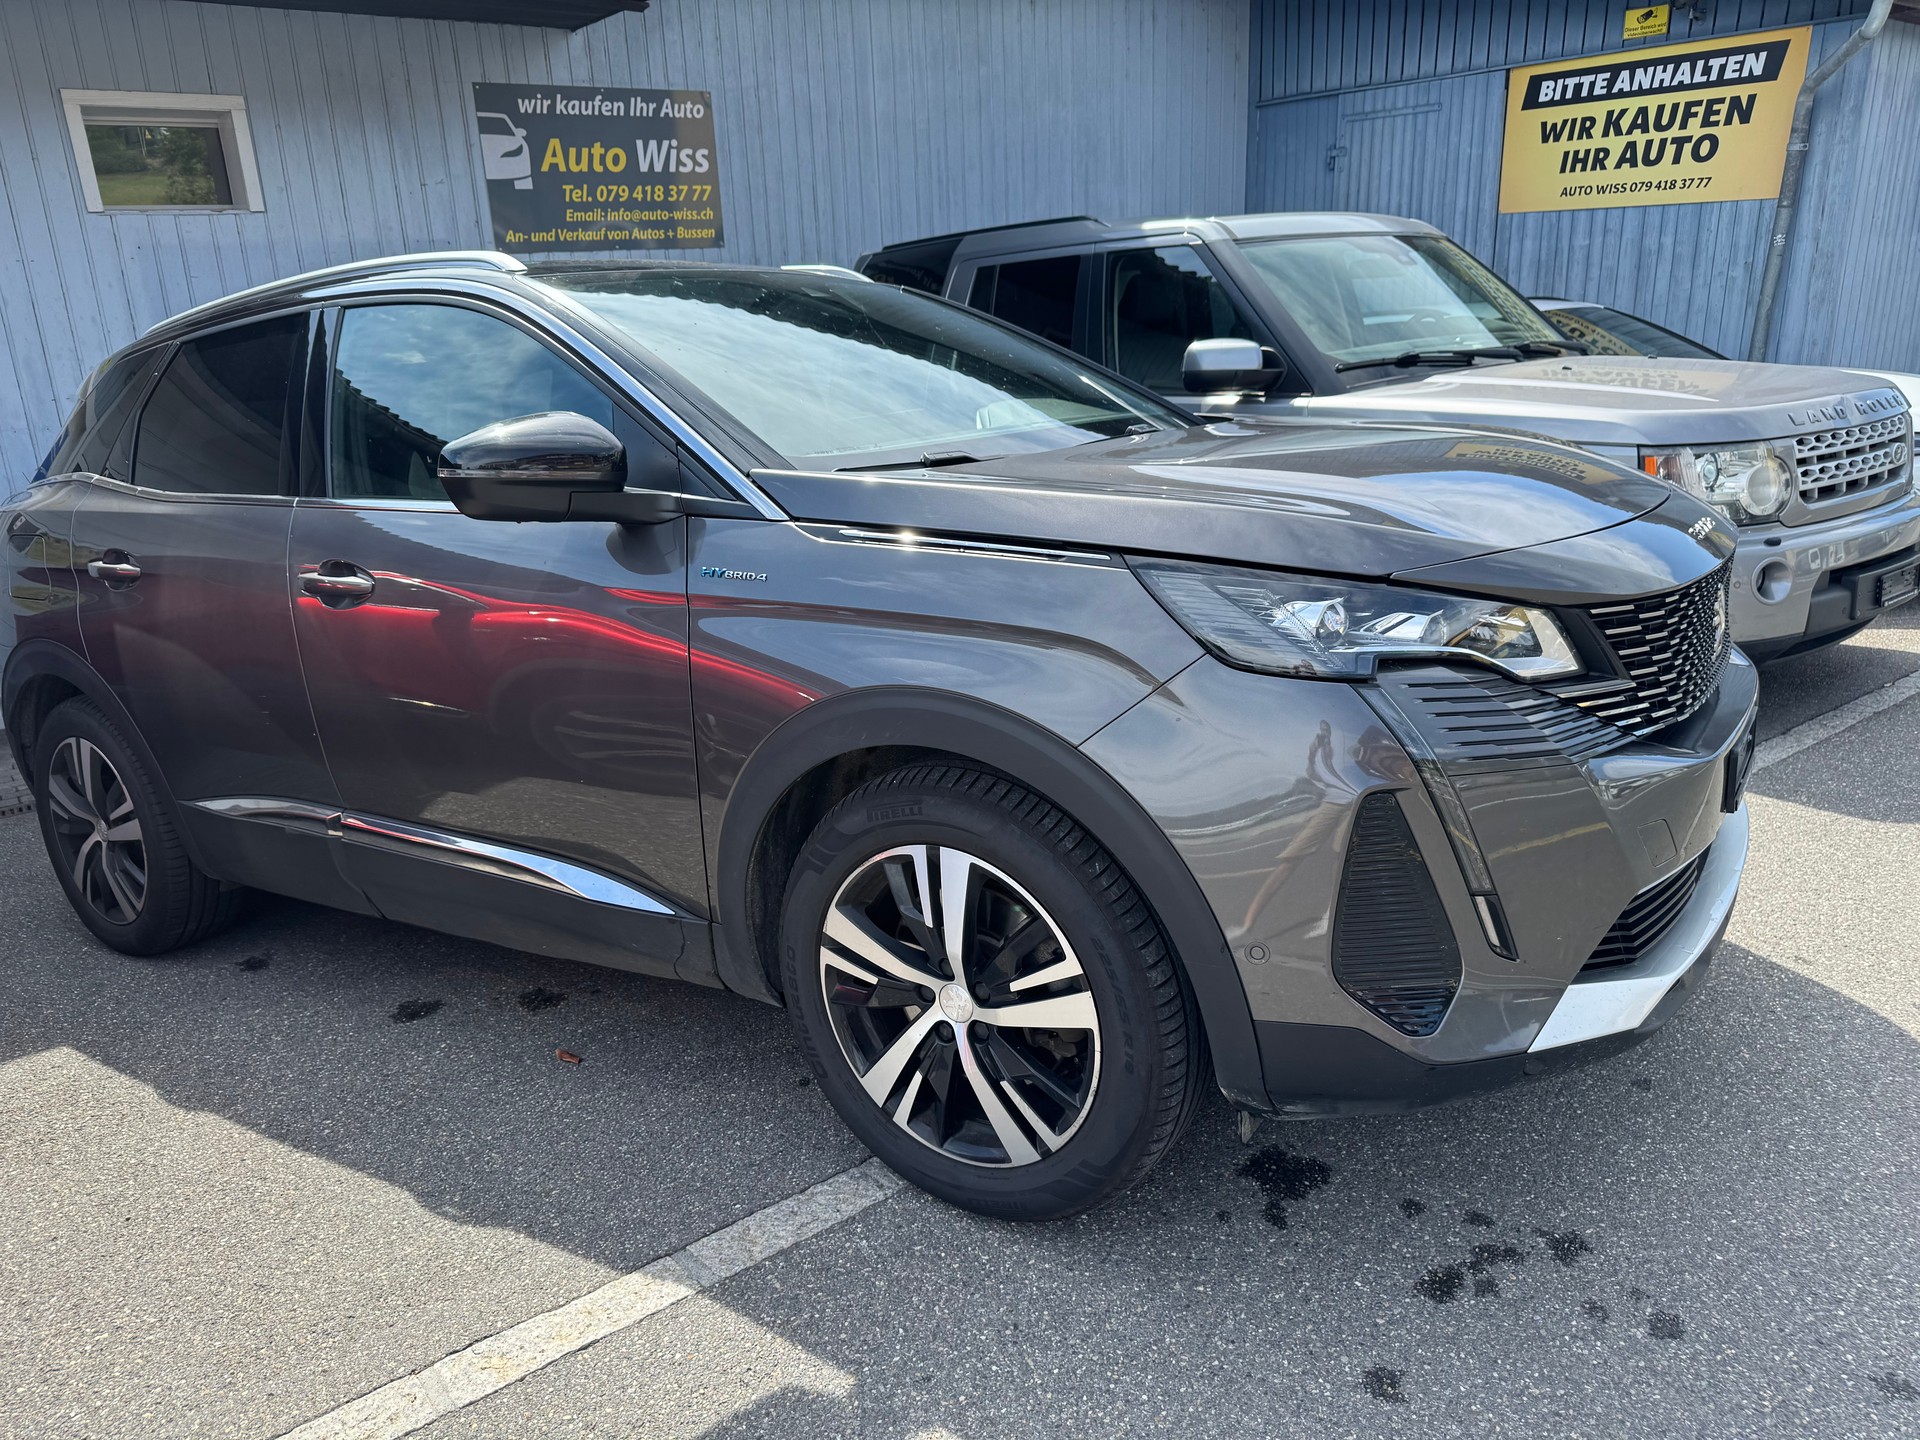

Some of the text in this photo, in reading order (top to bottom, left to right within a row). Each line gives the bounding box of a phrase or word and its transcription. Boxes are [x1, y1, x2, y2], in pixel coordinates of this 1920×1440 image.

[1538, 51, 1768, 102] BITTE ANHALTEN
[518, 94, 704, 118] wir kaufen Ihr Auto
[1540, 94, 1758, 144] WIR KAUFEN
[540, 138, 710, 173] Auto Wiss
[1559, 133, 1720, 174] IHR AUTO
[562, 184, 712, 202] Tel. 079 418 37 77
[1560, 177, 1712, 197] AUTO WISS 079 418 37 77
[566, 207, 714, 222] Email: info@auto-wiss.ch
[506, 230, 528, 242] An-
[531, 228, 556, 242] und
[558, 227, 606, 241] Verkauf
[606, 230, 629, 240] von
[632, 228, 665, 240] Autos
[677, 226, 716, 238] Bussen
[1788, 394, 1905, 426] LAND ROVER
[867, 800, 923, 822] PIRELLI
